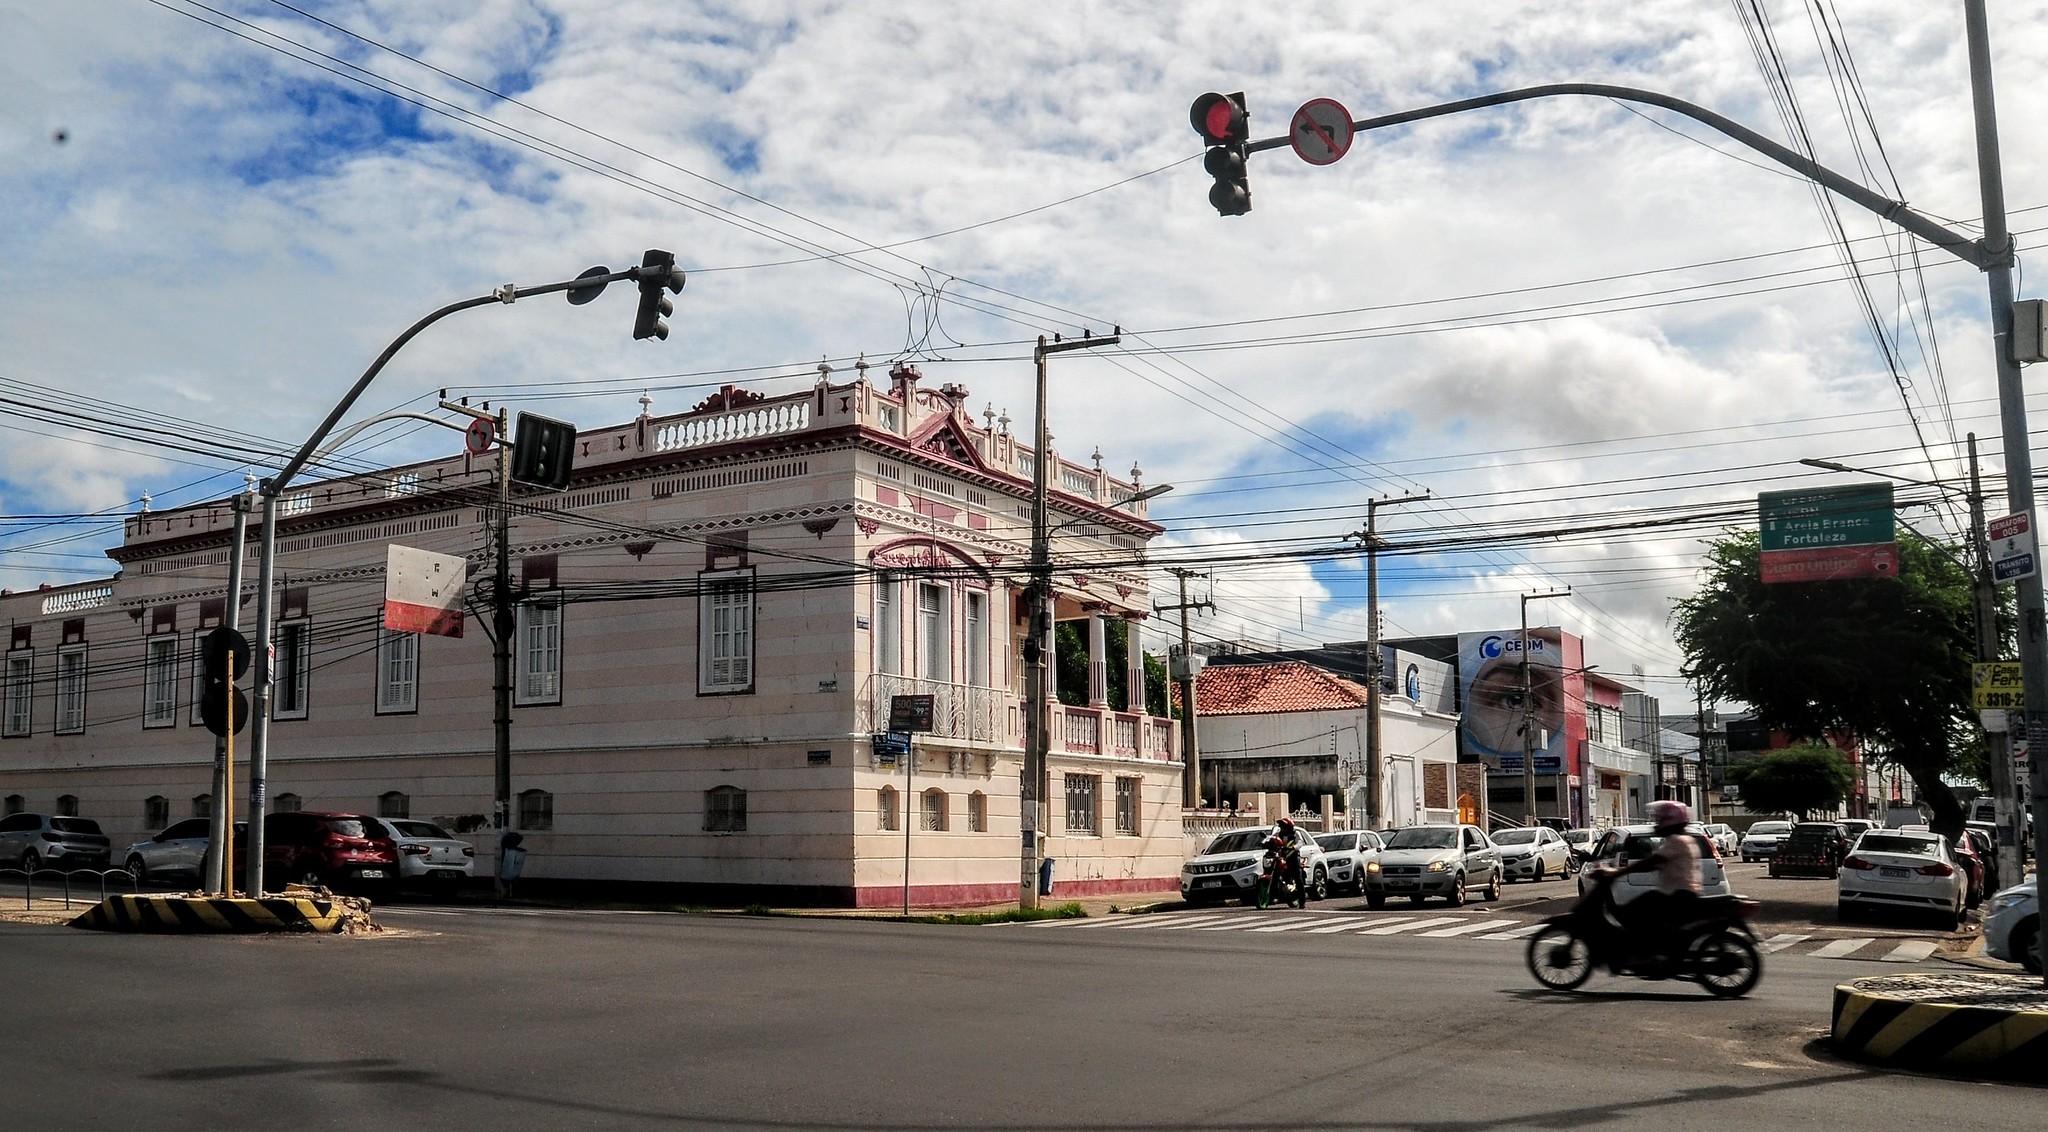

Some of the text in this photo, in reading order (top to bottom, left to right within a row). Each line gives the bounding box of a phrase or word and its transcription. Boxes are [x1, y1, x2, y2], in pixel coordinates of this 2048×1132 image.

[1784, 517, 1870, 532] Areia Branca
[2002, 526, 2019, 537] 005
[1784, 532, 1847, 545] Fortaleza
[1993, 665, 2019, 674] Casa
